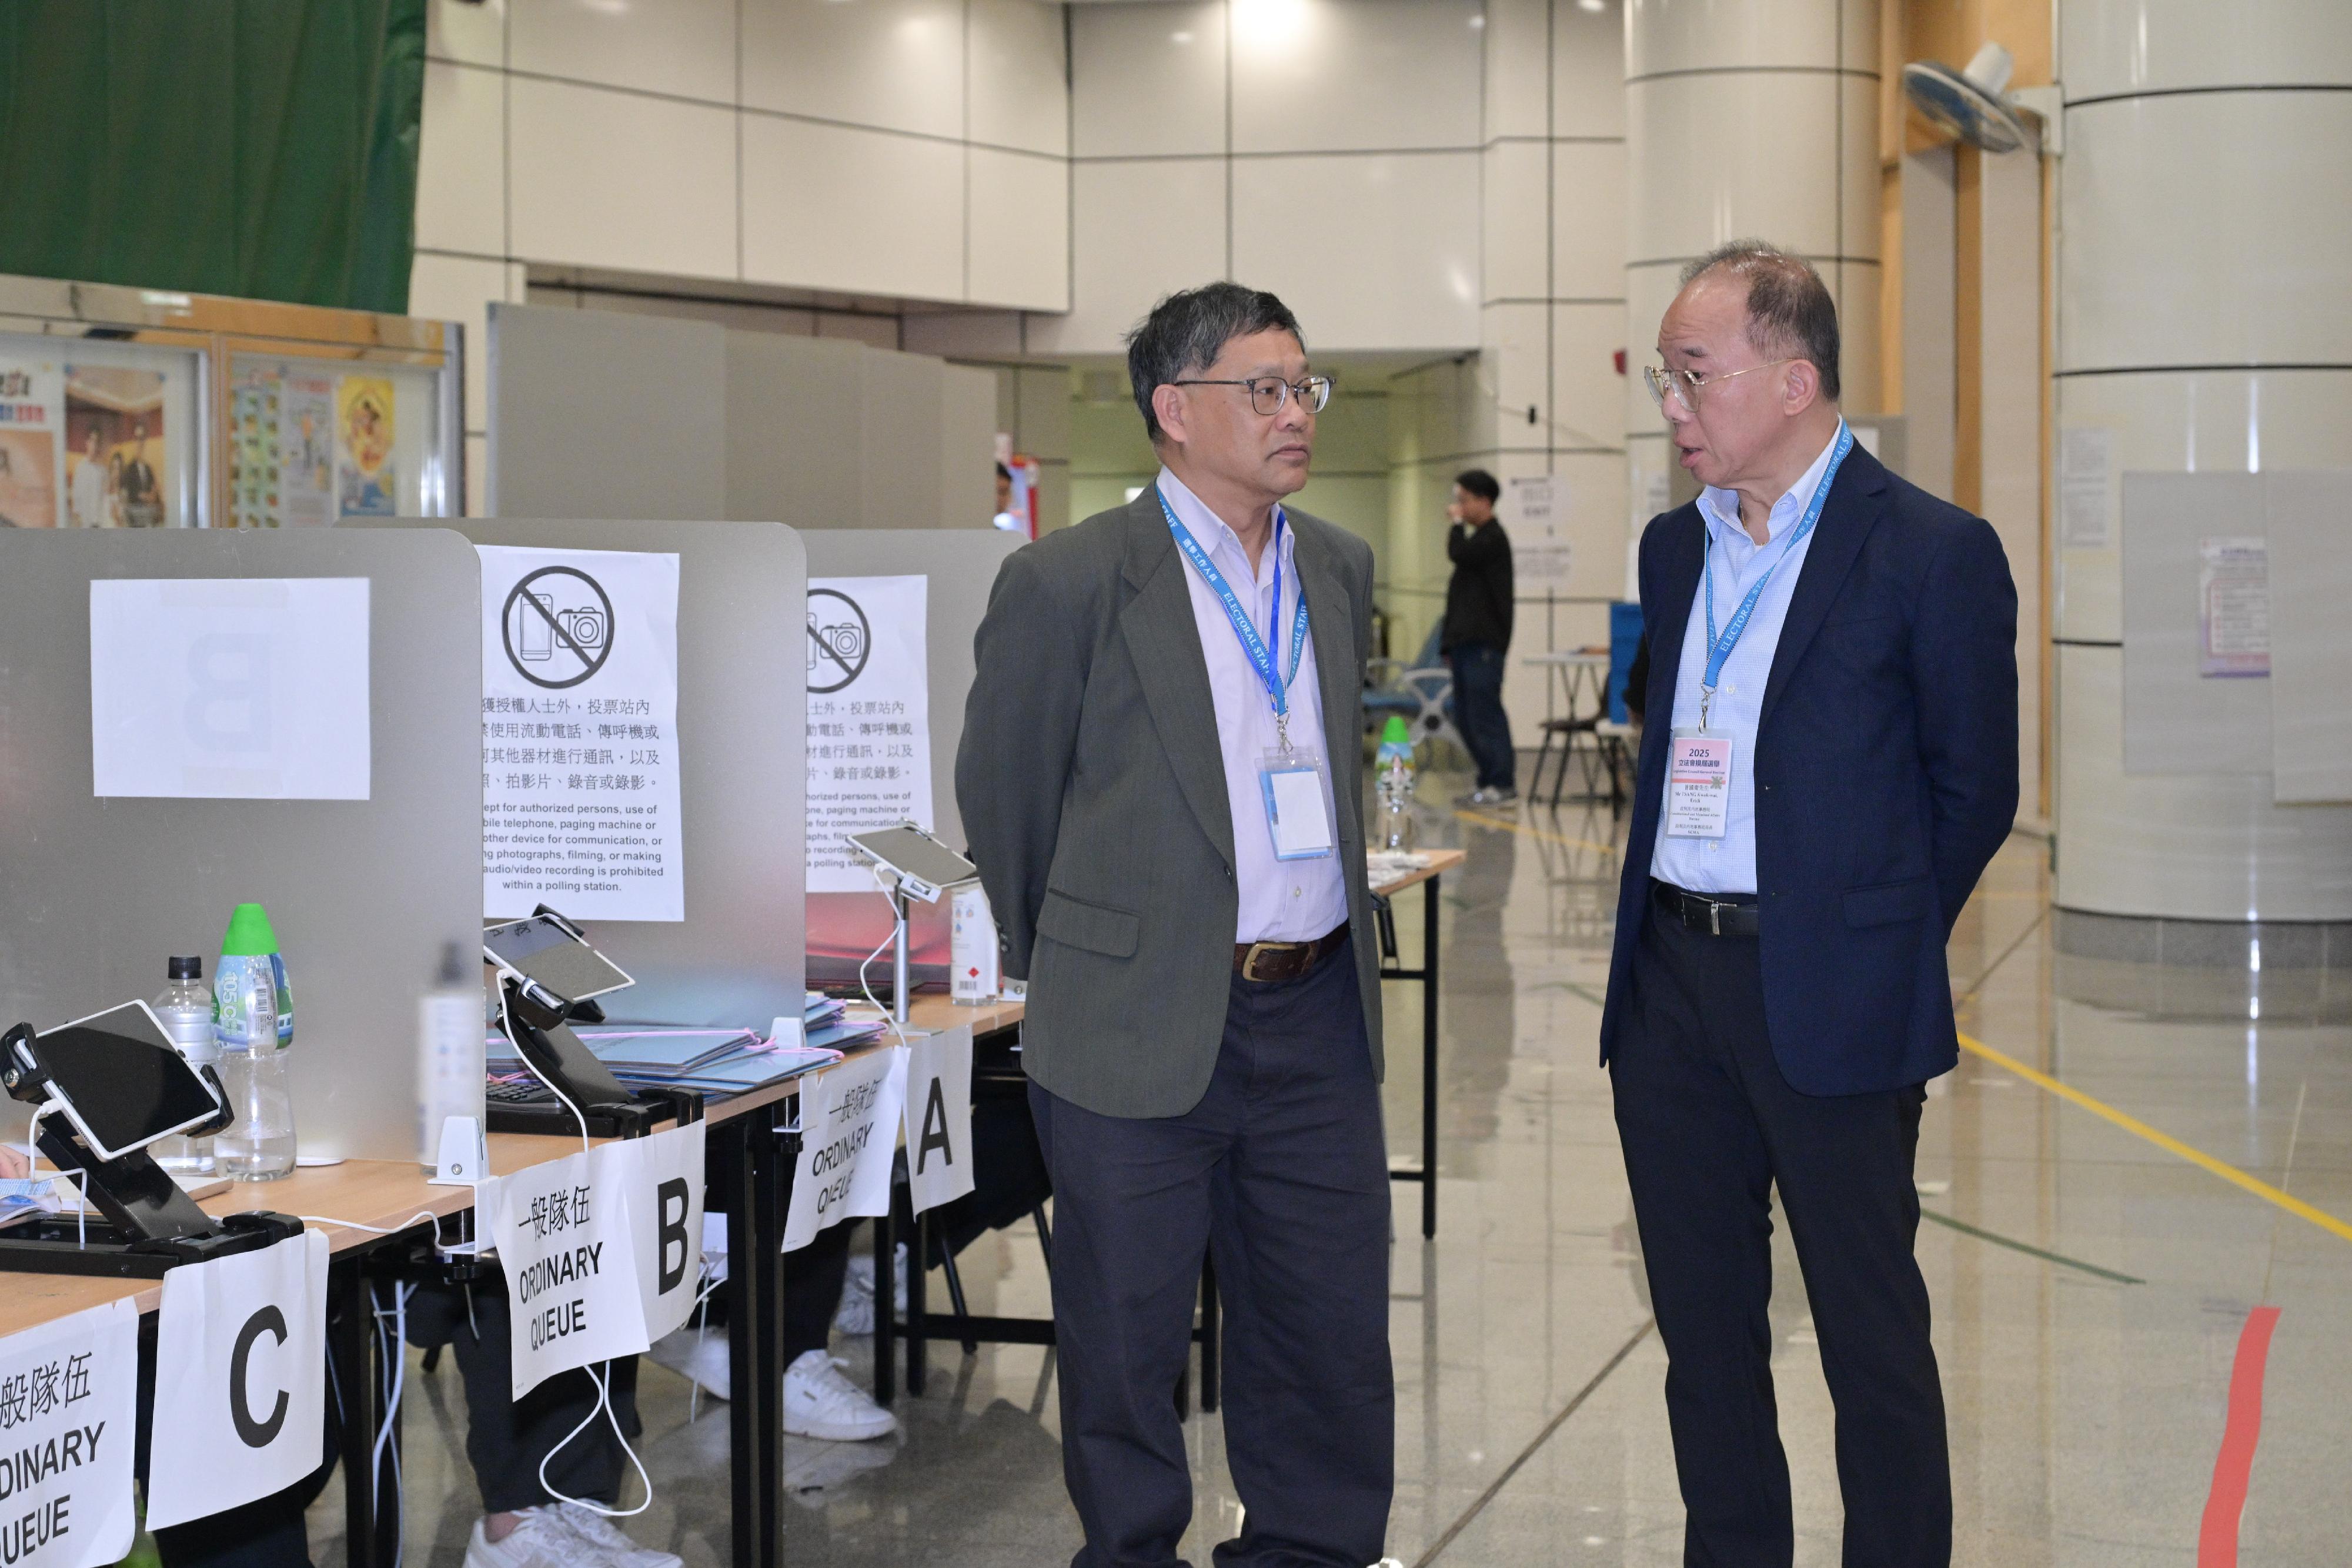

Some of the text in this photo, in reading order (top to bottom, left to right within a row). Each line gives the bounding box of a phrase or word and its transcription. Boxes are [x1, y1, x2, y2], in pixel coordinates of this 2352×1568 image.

[1818, 445, 1847, 498] ELECTORAL
[1224, 593, 1256, 646] ELECTORAL
[1720, 597, 1755, 652] ELECTORAL
[807, 701, 904, 715] 士外，投票站內
[1689, 748, 1709, 757] 2025
[841, 794, 880, 802] persons,
[902, 791, 911, 800] of
[503, 803, 517, 811] for
[520, 804, 573, 813] authorized
[577, 806, 621, 815] persons,
[647, 805, 657, 814] of
[827, 807, 857, 815] paging
[504, 818, 556, 829] telephone,
[560, 820, 594, 831] paging
[599, 820, 642, 829] machine
[483, 833, 508, 845] other
[512, 834, 544, 843] device
[548, 834, 562, 843] for
[566, 835, 647, 846] communication,
[497, 849, 564, 861] photographs,
[568, 850, 605, 862] filming,
[623, 852, 661, 862] making
[814, 846, 857, 855] recording
[483, 864, 663, 877] audio/video recording is prohibited
[814, 859, 844, 868] polling
[503, 880, 533, 889] within
[546, 881, 580, 892] polling
[584, 882, 621, 891] station.
[917, 1076, 953, 1176] A
[812, 1122, 874, 1177] ORDINARY
[517, 1185, 591, 1242] 一般隊伍
[657, 1176, 689, 1296] B
[520, 1241, 603, 1304] ORDINARY
[530, 1299, 586, 1351] QUEUE
[230, 1304, 289, 1448] C
[0, 1494, 71, 1568] UEUE
